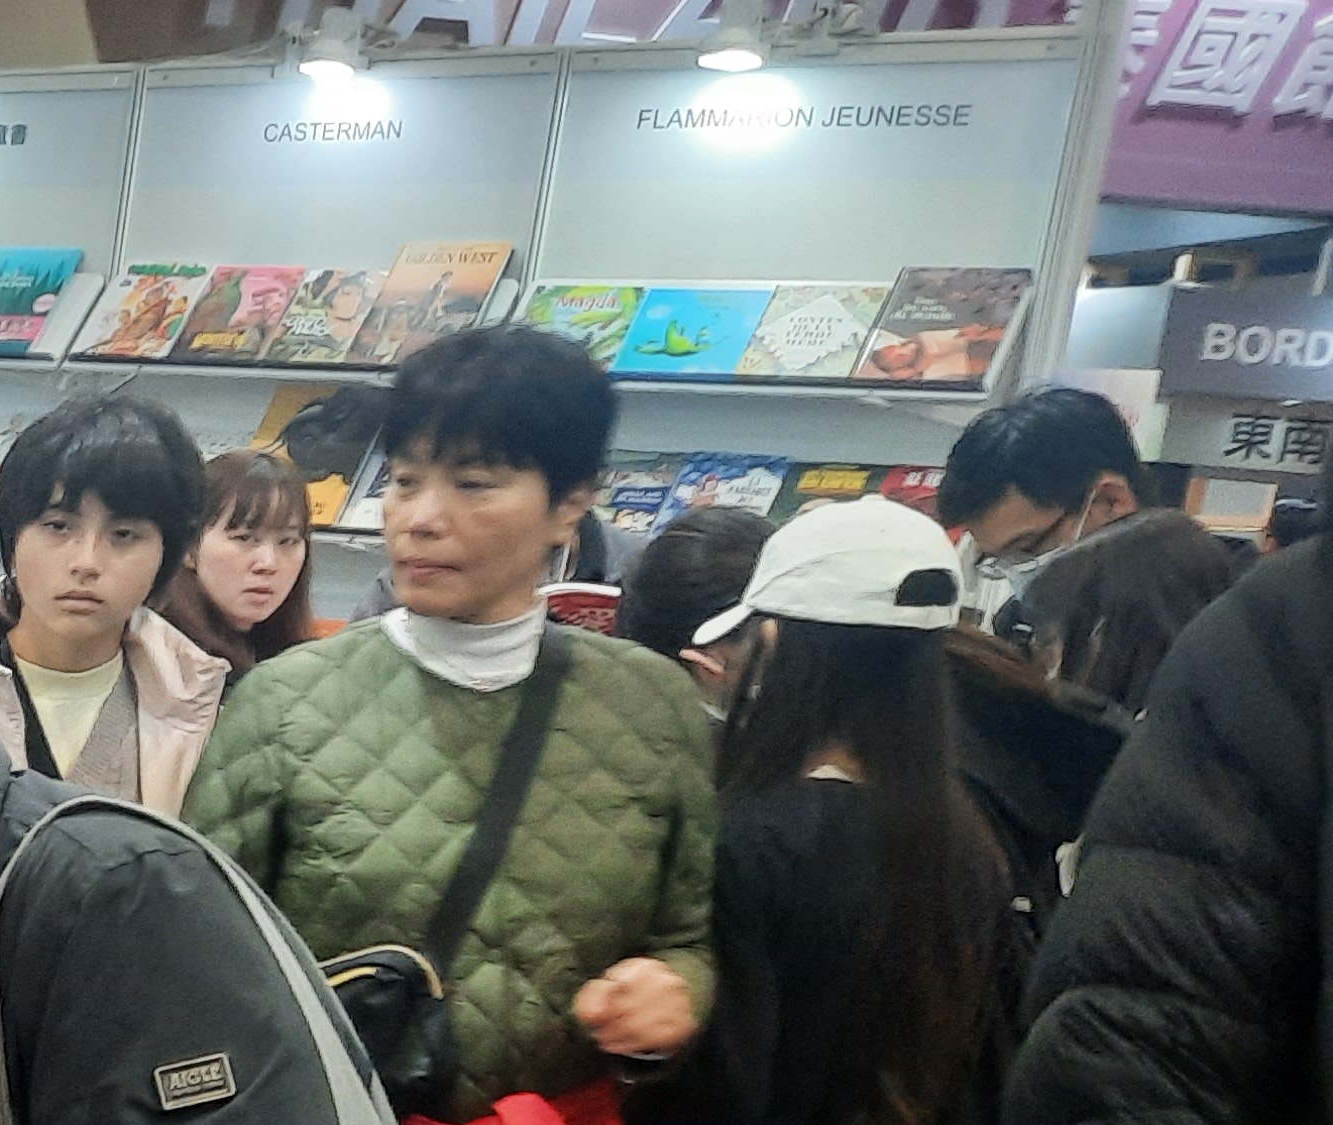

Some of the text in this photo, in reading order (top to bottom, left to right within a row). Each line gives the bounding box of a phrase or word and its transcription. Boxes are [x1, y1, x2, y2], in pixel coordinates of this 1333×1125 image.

[821, 103, 973, 130] JEUNESSE
[262, 119, 403, 144] CASTERMAN
[456, 250, 499, 264] WEST
